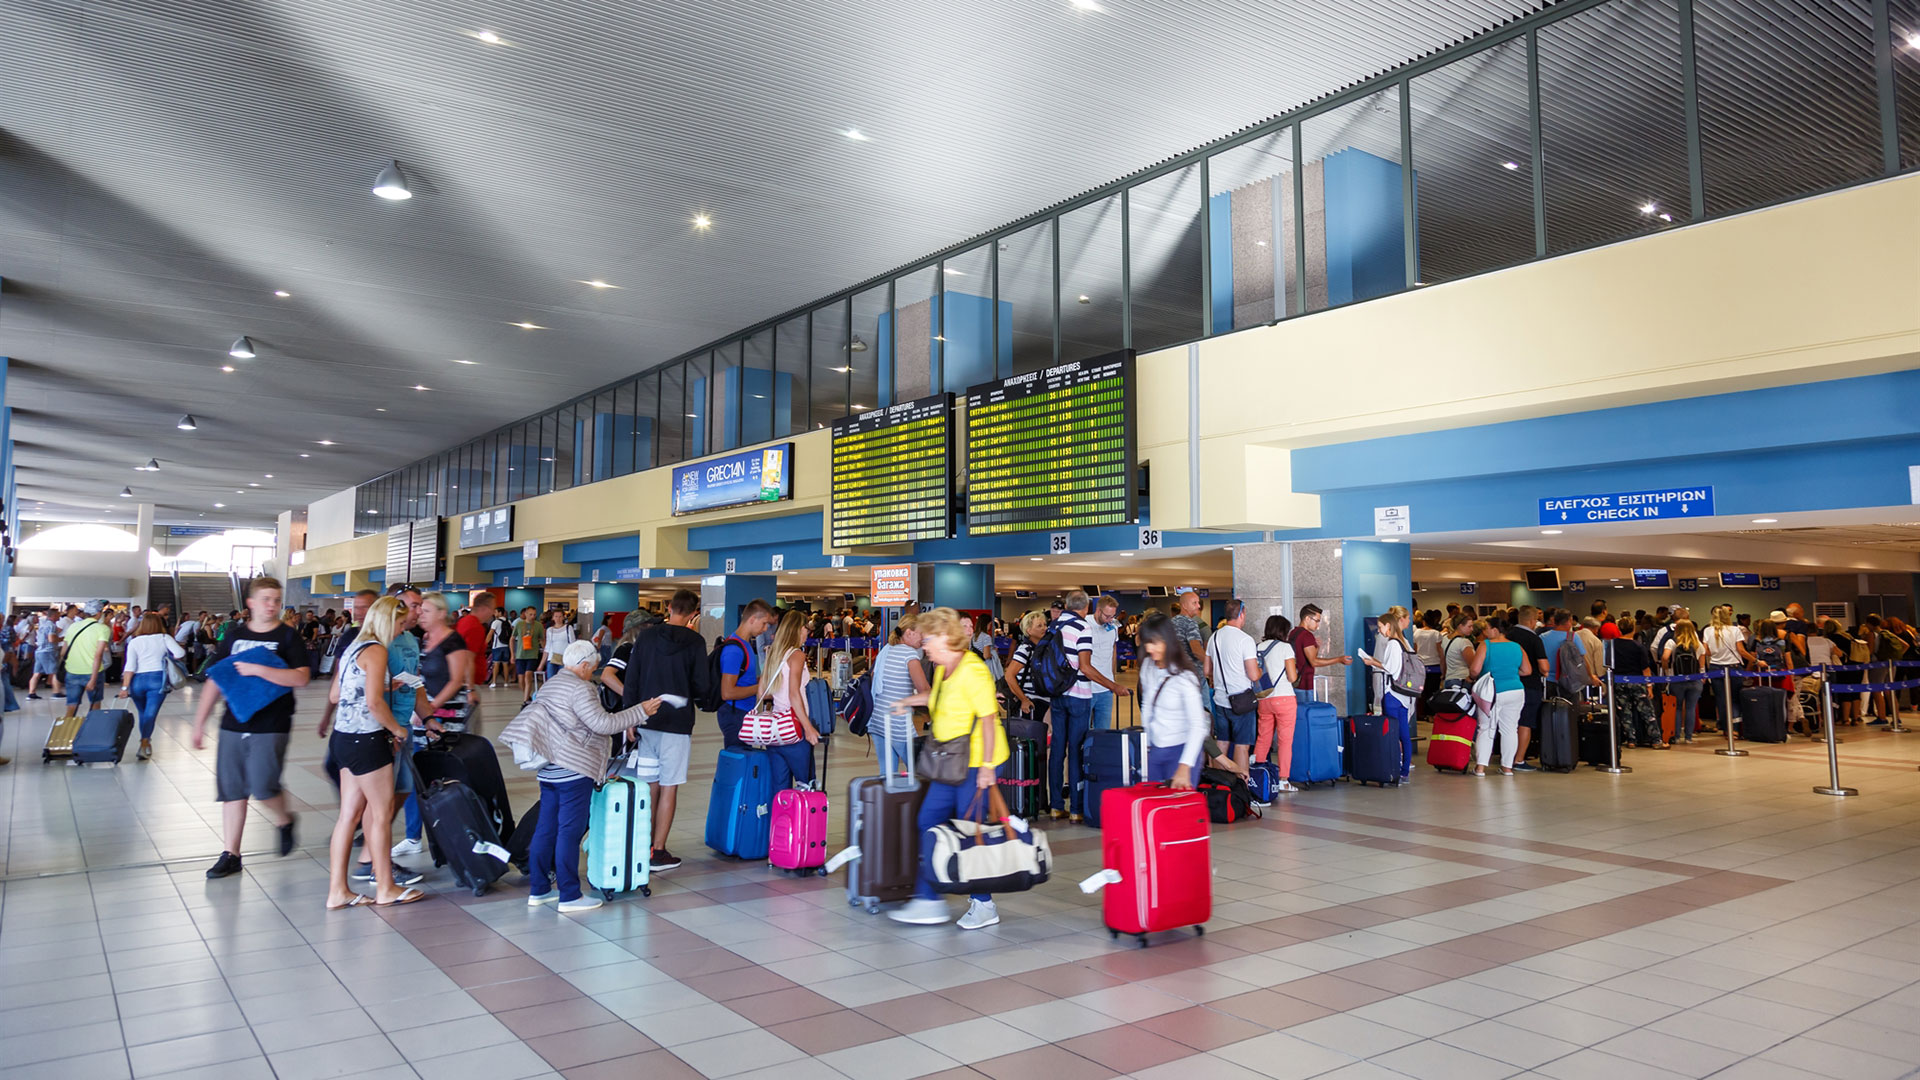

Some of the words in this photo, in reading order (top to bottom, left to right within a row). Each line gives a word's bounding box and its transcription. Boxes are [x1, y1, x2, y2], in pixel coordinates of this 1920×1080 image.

[1046, 362, 1080, 377] DEPARTURES
[1060, 388, 1072, 398] 1120
[1060, 400, 1072, 410] 1130
[1060, 411, 1072, 421] 1130
[1060, 423, 1072, 433] 1135
[1060, 435, 1072, 445] 1145
[1060, 446, 1072, 456] 1155
[1060, 494, 1072, 503] 1225
[1545, 497, 1610, 510] ΕΛΕΓΧΟΣ
[1619, 490, 1706, 505] ΕΙΣΙΤΗΡΙΩΝ
[1587, 508, 1639, 520] CHECK
[1644, 507, 1658, 516] IN
[1143, 530, 1158, 545] 36
[1053, 536, 1066, 550] 35
[874, 568, 908, 581] упаковка
[877, 579, 904, 590] багажа
[1461, 585, 1473, 593] 33
[1570, 582, 1584, 592] 34
[1680, 580, 1695, 590] 35
[1763, 579, 1778, 589] 36
